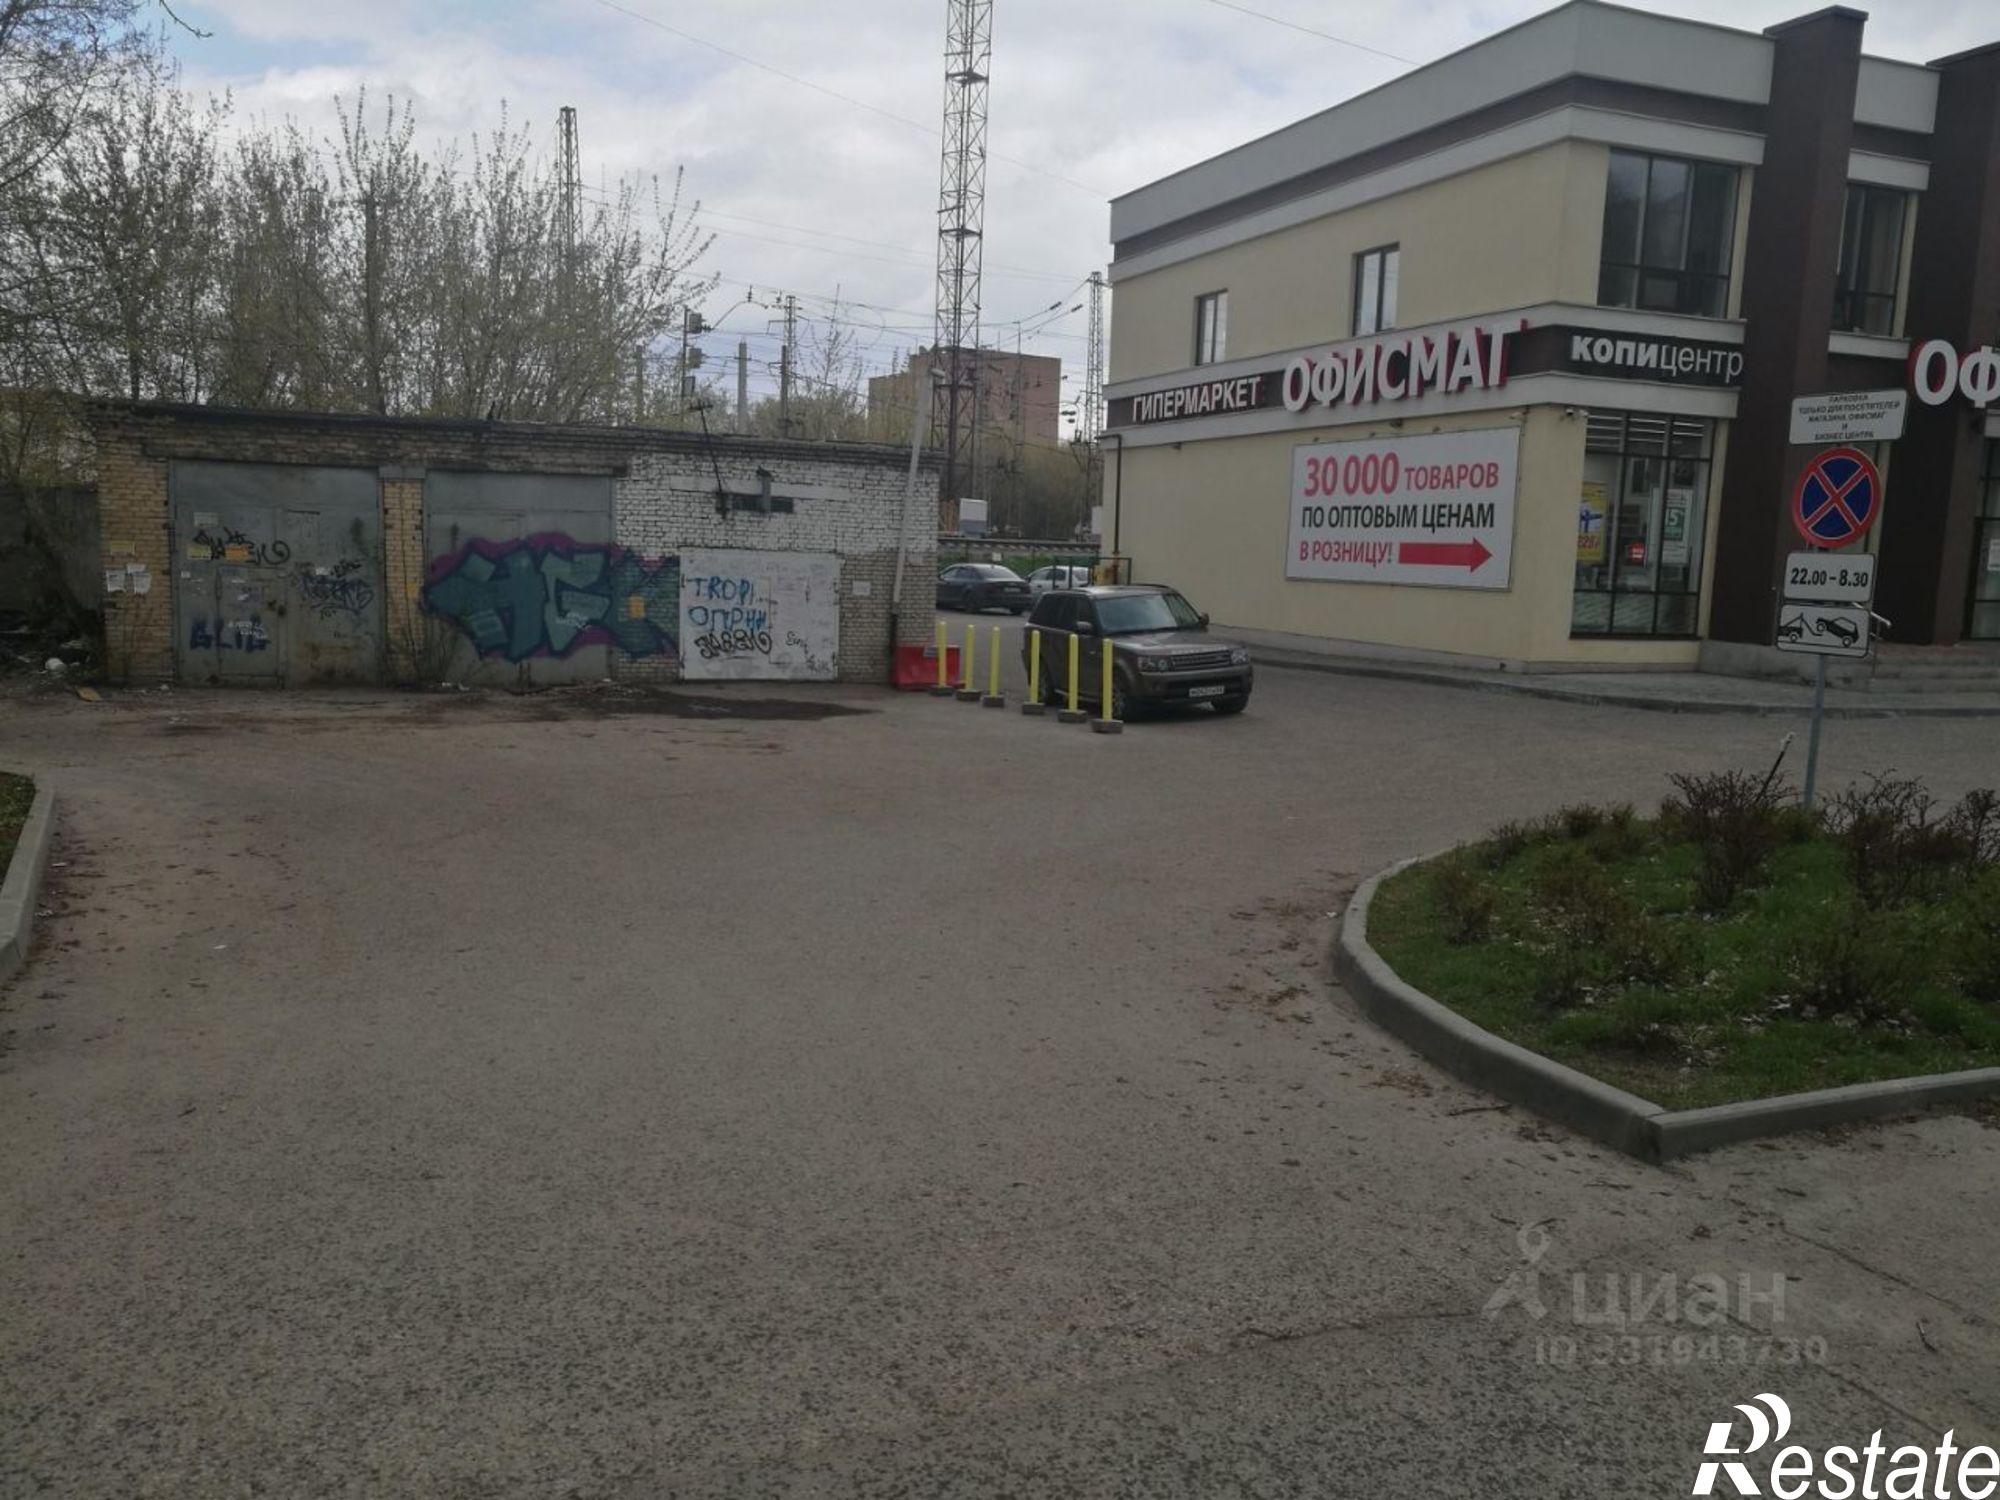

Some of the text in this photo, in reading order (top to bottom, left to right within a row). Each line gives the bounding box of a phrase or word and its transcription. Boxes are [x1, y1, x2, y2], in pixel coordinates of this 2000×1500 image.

[1282, 318, 1527, 412] ОФИСМАГ
[1132, 376, 1262, 423] ГИПЕРМАРКЕТ
[1404, 462, 1499, 491] ТОВАРОВ
[1302, 502, 1495, 534] ПО ОПТОВЫМ ЦЕНАМ
[1300, 540, 1394, 568] В РОЗНИЦУ!
